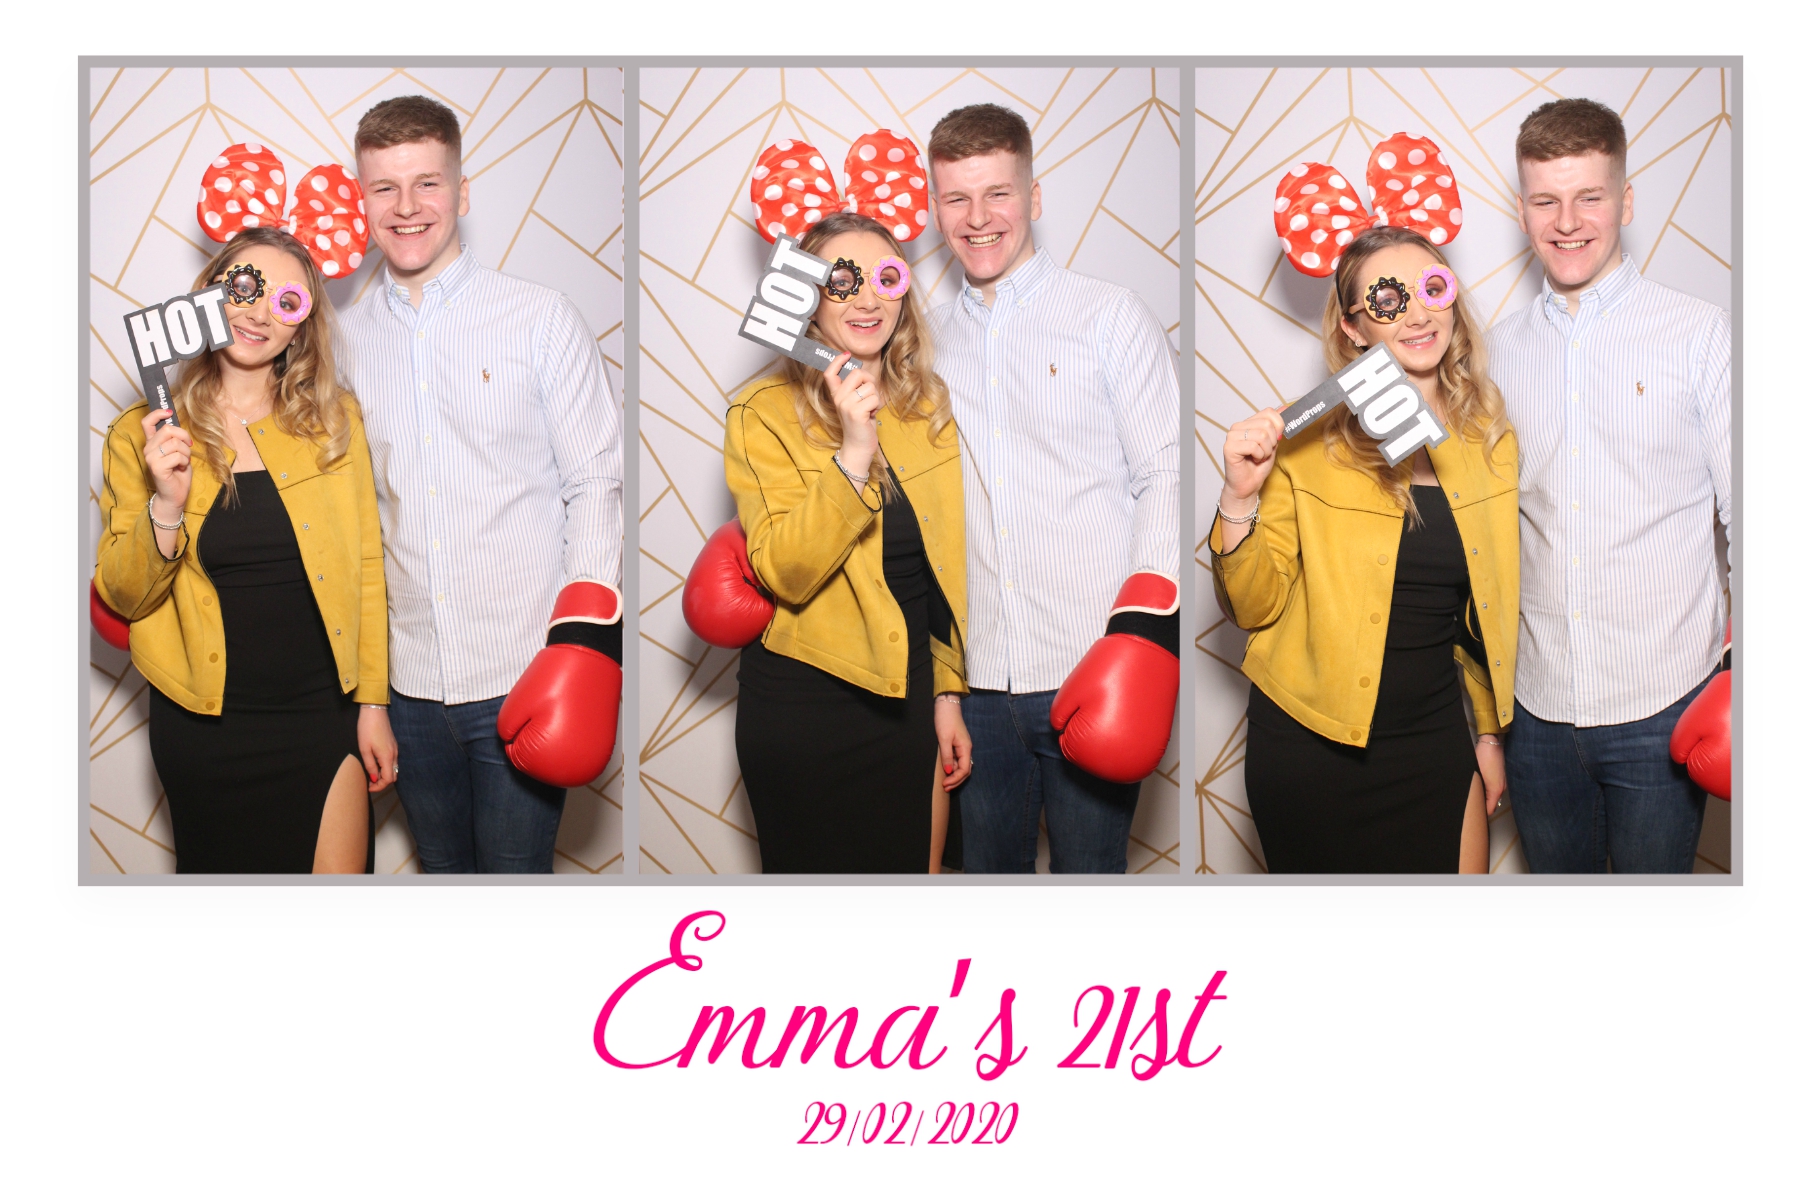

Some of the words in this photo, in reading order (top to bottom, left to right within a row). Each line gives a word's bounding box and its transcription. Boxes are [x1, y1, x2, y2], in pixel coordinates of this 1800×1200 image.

[129, 287, 228, 368] HOT
[743, 238, 828, 352] HOT
[1284, 401, 1326, 433] #WordProps
[1337, 347, 1444, 461] HOT
